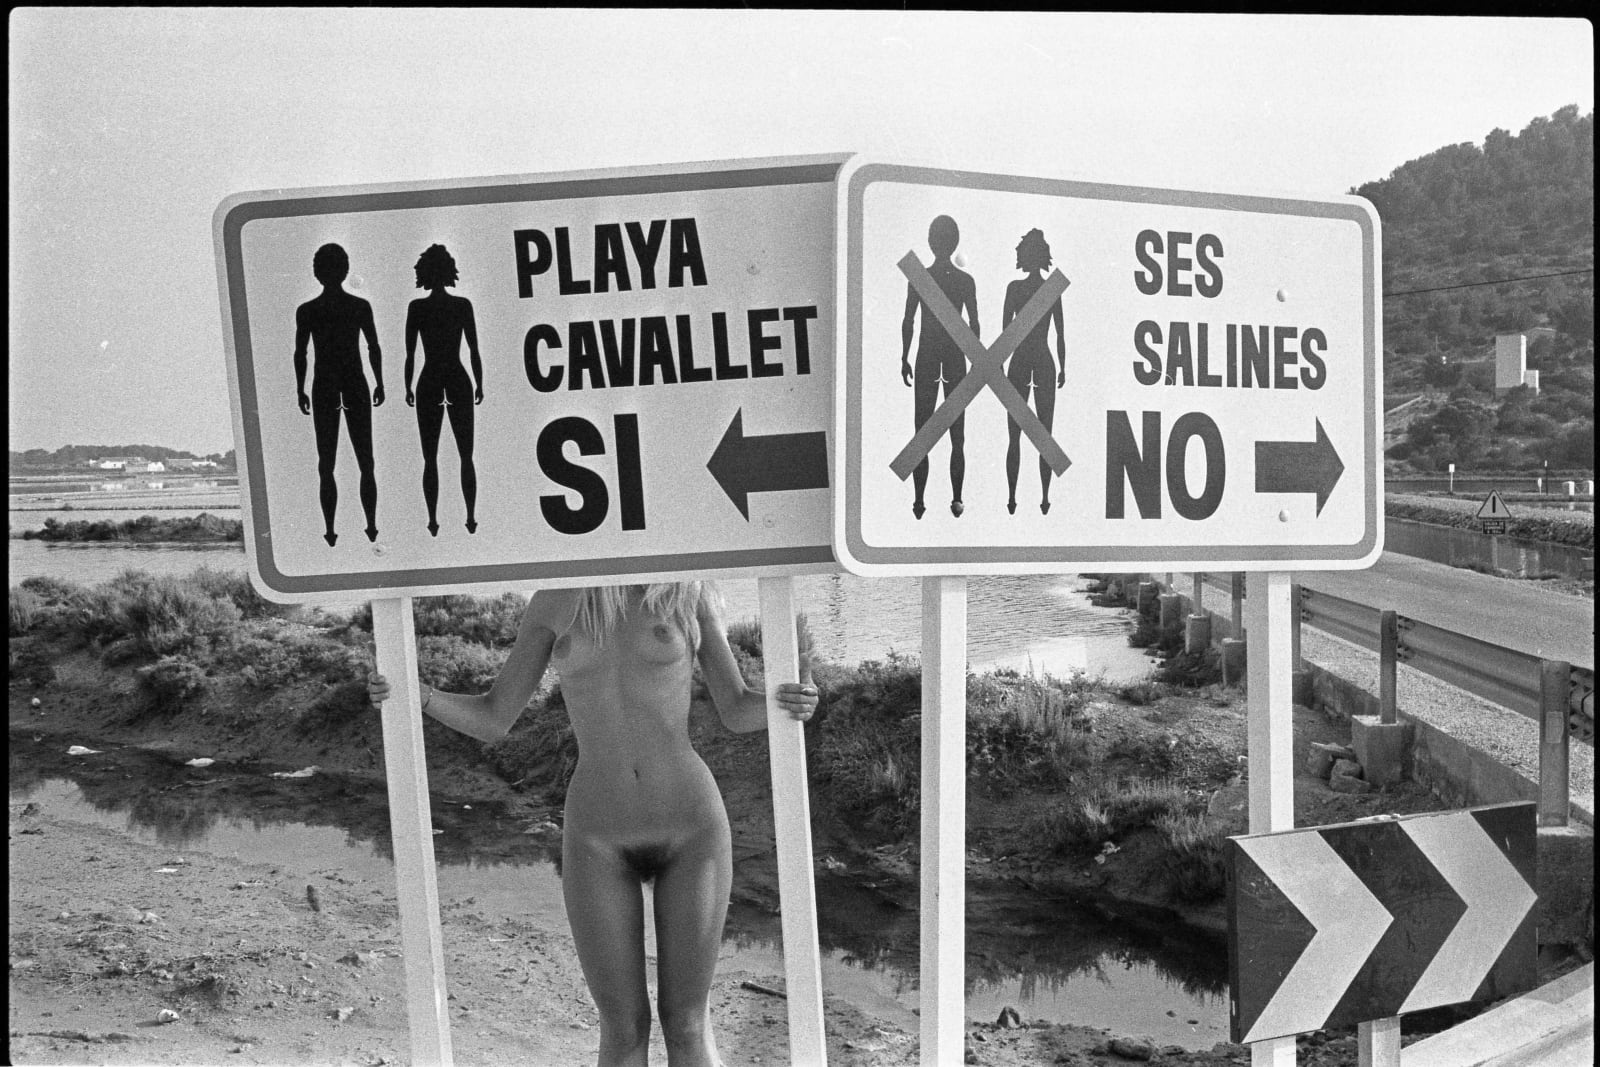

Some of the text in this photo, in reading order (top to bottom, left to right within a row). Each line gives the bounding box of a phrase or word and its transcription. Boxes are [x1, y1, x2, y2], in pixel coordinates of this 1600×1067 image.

[514, 218, 707, 298] PLAYA
[1135, 230, 1223, 298] SES
[524, 306, 817, 392] CAVALLET
[1133, 320, 1327, 390] SALINES
[537, 414, 645, 534] SI
[1106, 410, 1225, 520] NO
